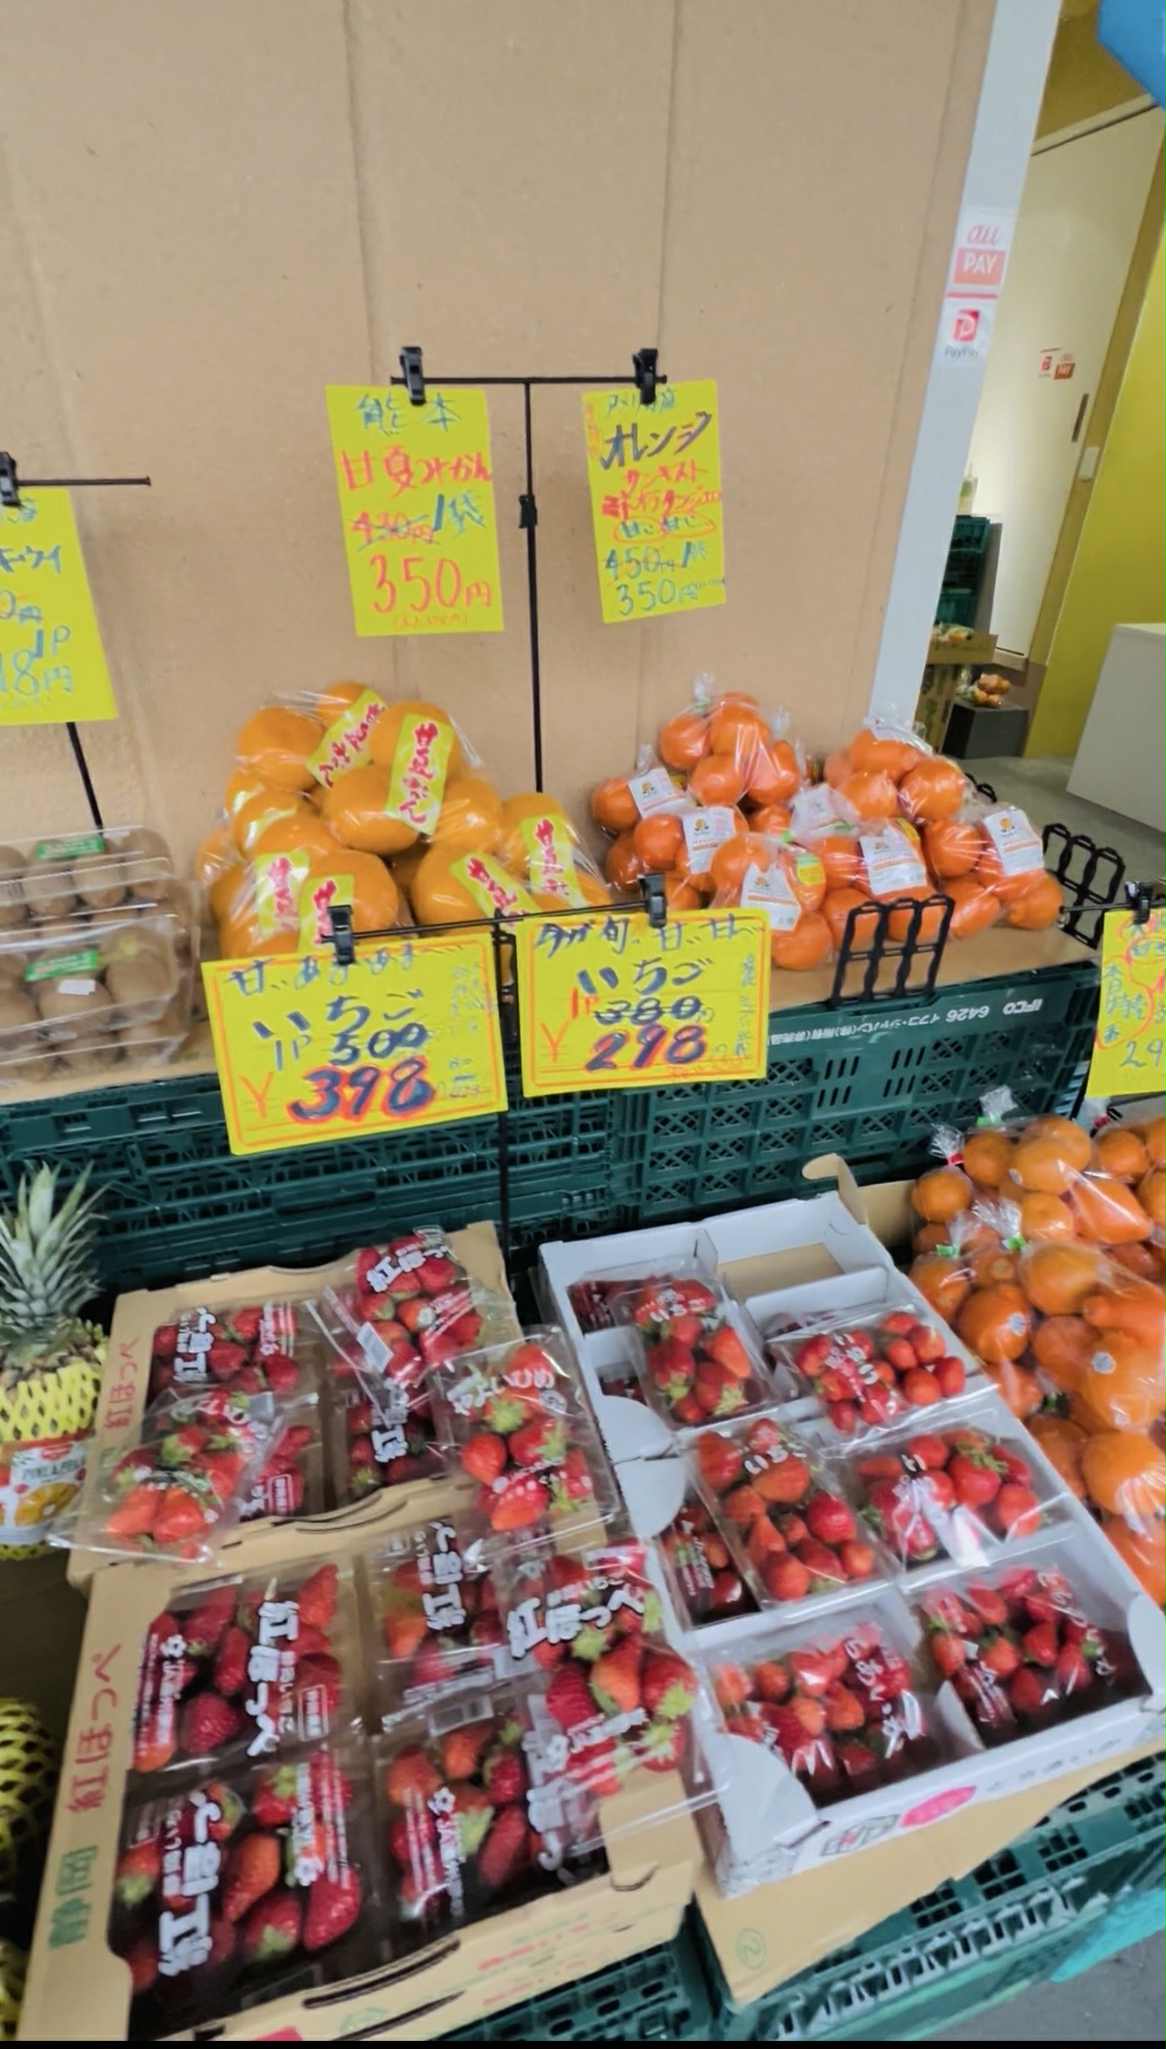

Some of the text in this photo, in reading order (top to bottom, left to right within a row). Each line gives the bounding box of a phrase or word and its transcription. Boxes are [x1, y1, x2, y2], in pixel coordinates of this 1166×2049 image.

[963, 252, 996, 274] PAY
[600, 410, 712, 470] オレンジ
[369, 553, 492, 614] 350円
[577, 957, 713, 995] いちご
[945, 1004, 990, 1024] 6426
[1003, 998, 1044, 1016] IFCO
[66, 1644, 122, 1815] 紅ほっぺ
